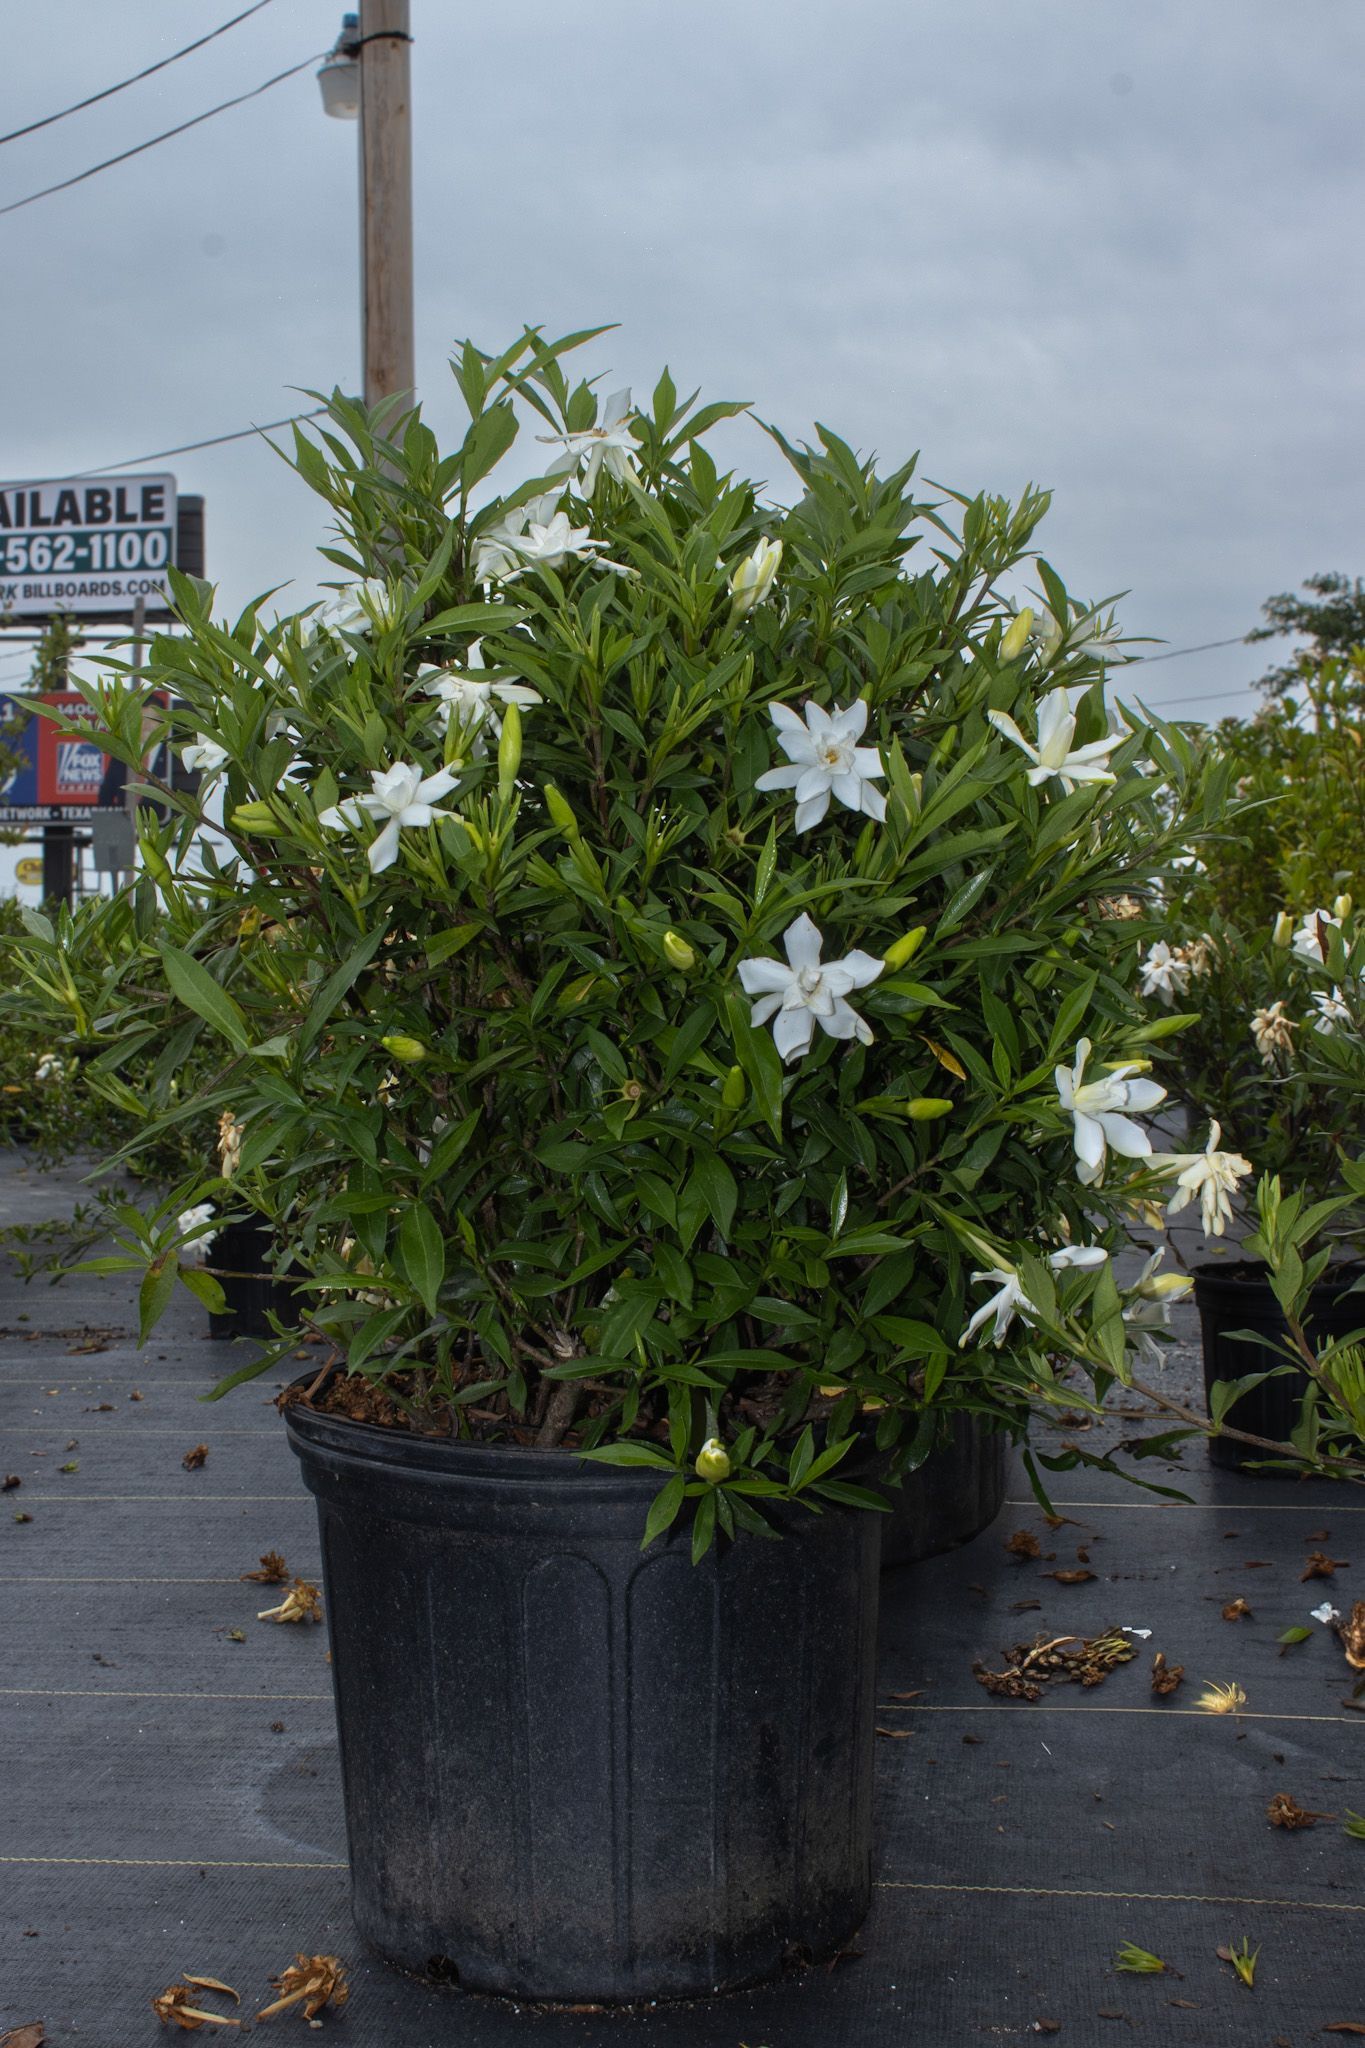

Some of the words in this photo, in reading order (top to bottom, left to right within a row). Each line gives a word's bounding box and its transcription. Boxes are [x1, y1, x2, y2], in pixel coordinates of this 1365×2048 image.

[23, 580, 165, 598] BILLBOARDS.COM
[71, 753, 100, 767] FOX
[63, 768, 102, 781] NEWS
